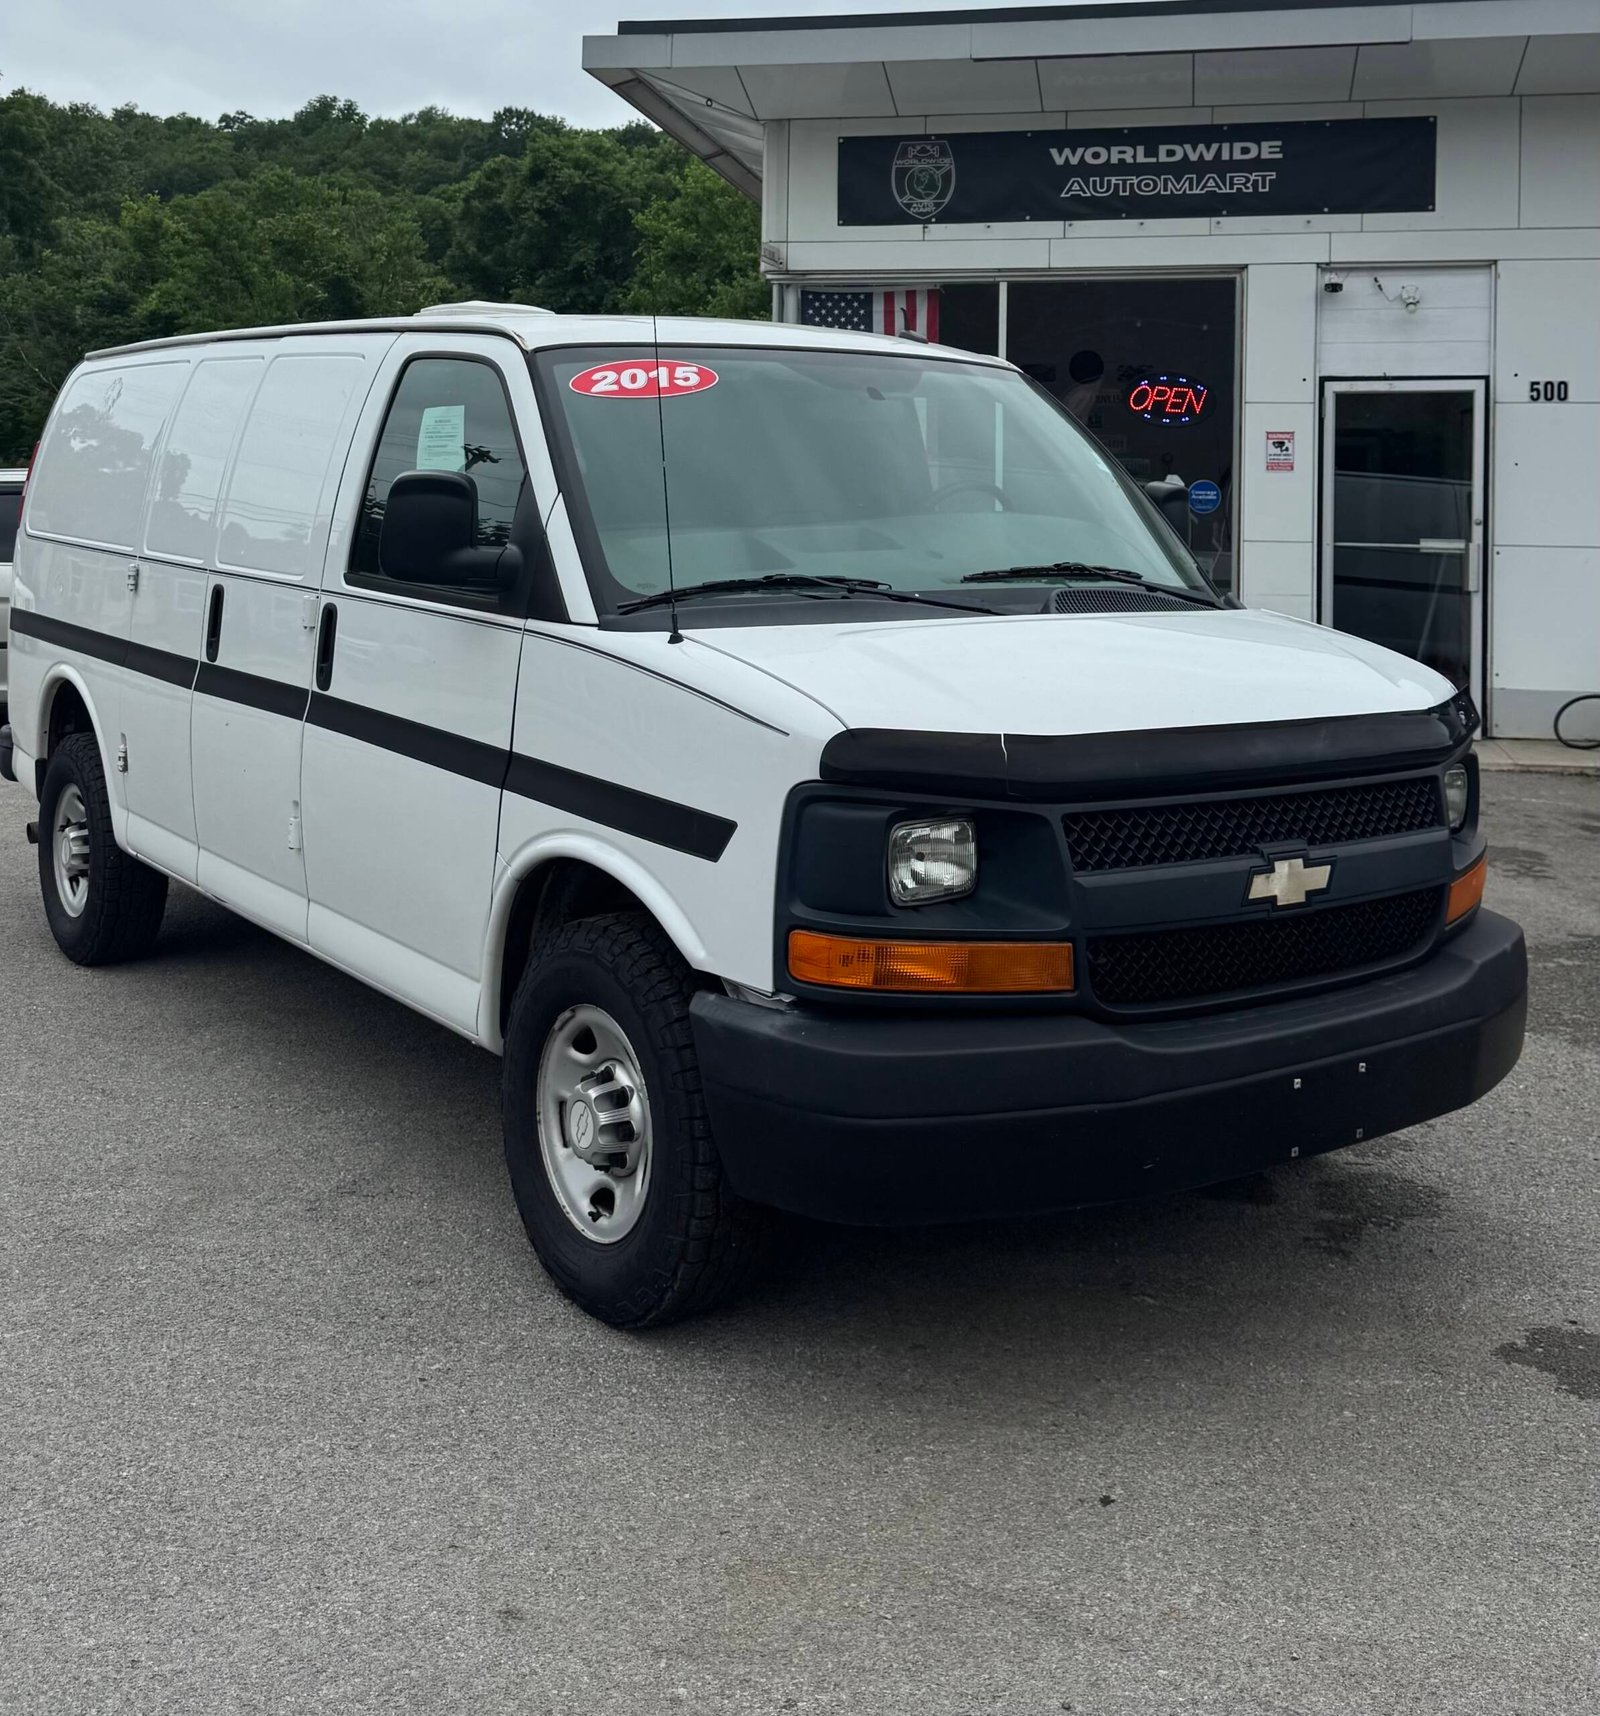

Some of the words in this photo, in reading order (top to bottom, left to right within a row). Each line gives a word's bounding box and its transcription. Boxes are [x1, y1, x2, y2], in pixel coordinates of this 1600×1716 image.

[1049, 140, 1284, 166] WORLDWIDE
[1060, 172, 1276, 197] AUTOMART
[590, 366, 701, 393] 2015
[1529, 381, 1568, 402] 500
[1129, 385, 1208, 414] OPEN
